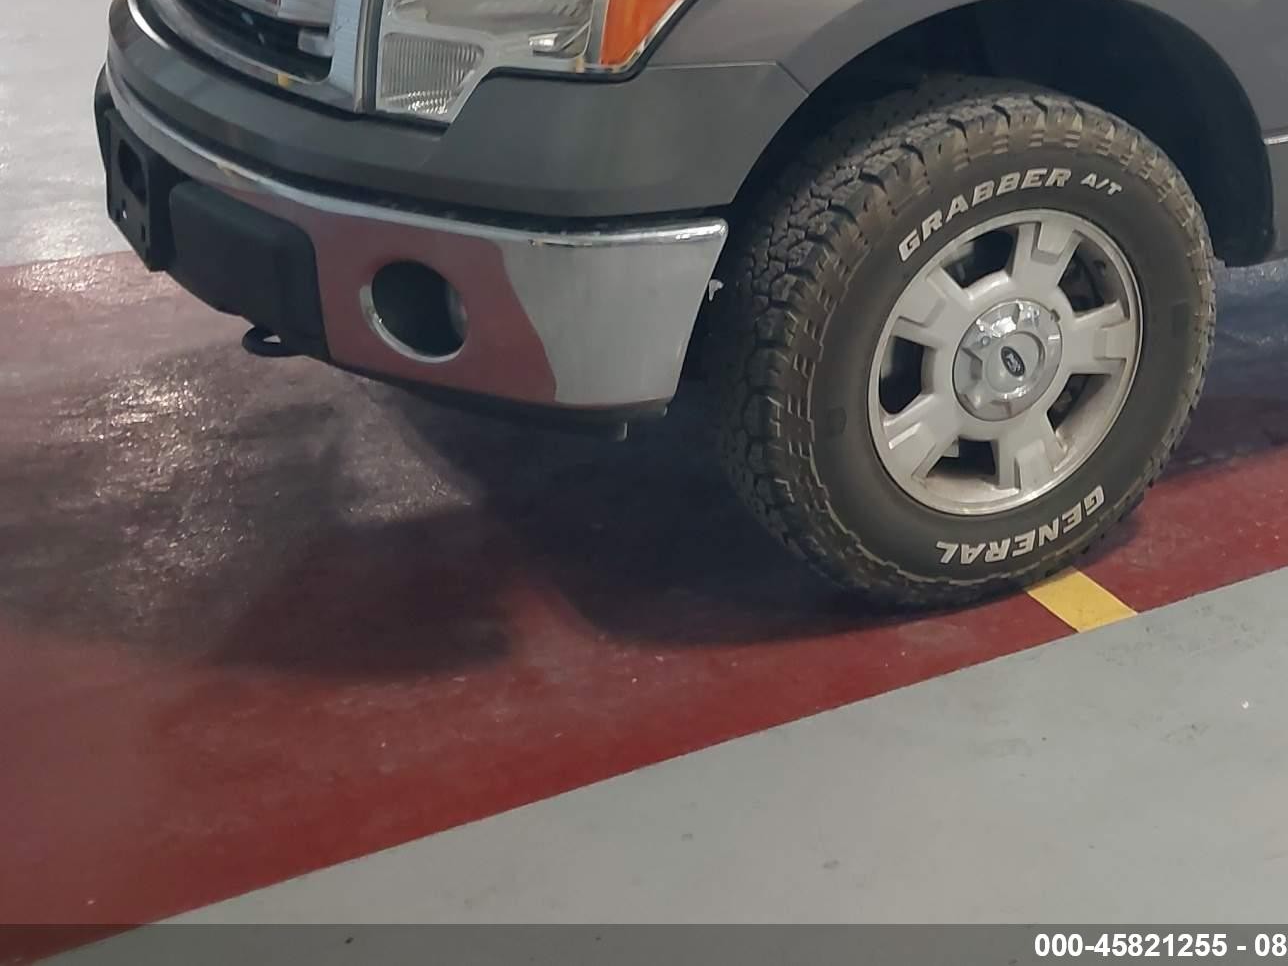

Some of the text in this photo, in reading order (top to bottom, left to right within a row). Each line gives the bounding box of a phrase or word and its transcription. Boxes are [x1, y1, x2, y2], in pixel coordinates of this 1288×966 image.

[898, 167, 1123, 263] GRABBER A/T
[936, 484, 1106, 566] GENERAL
